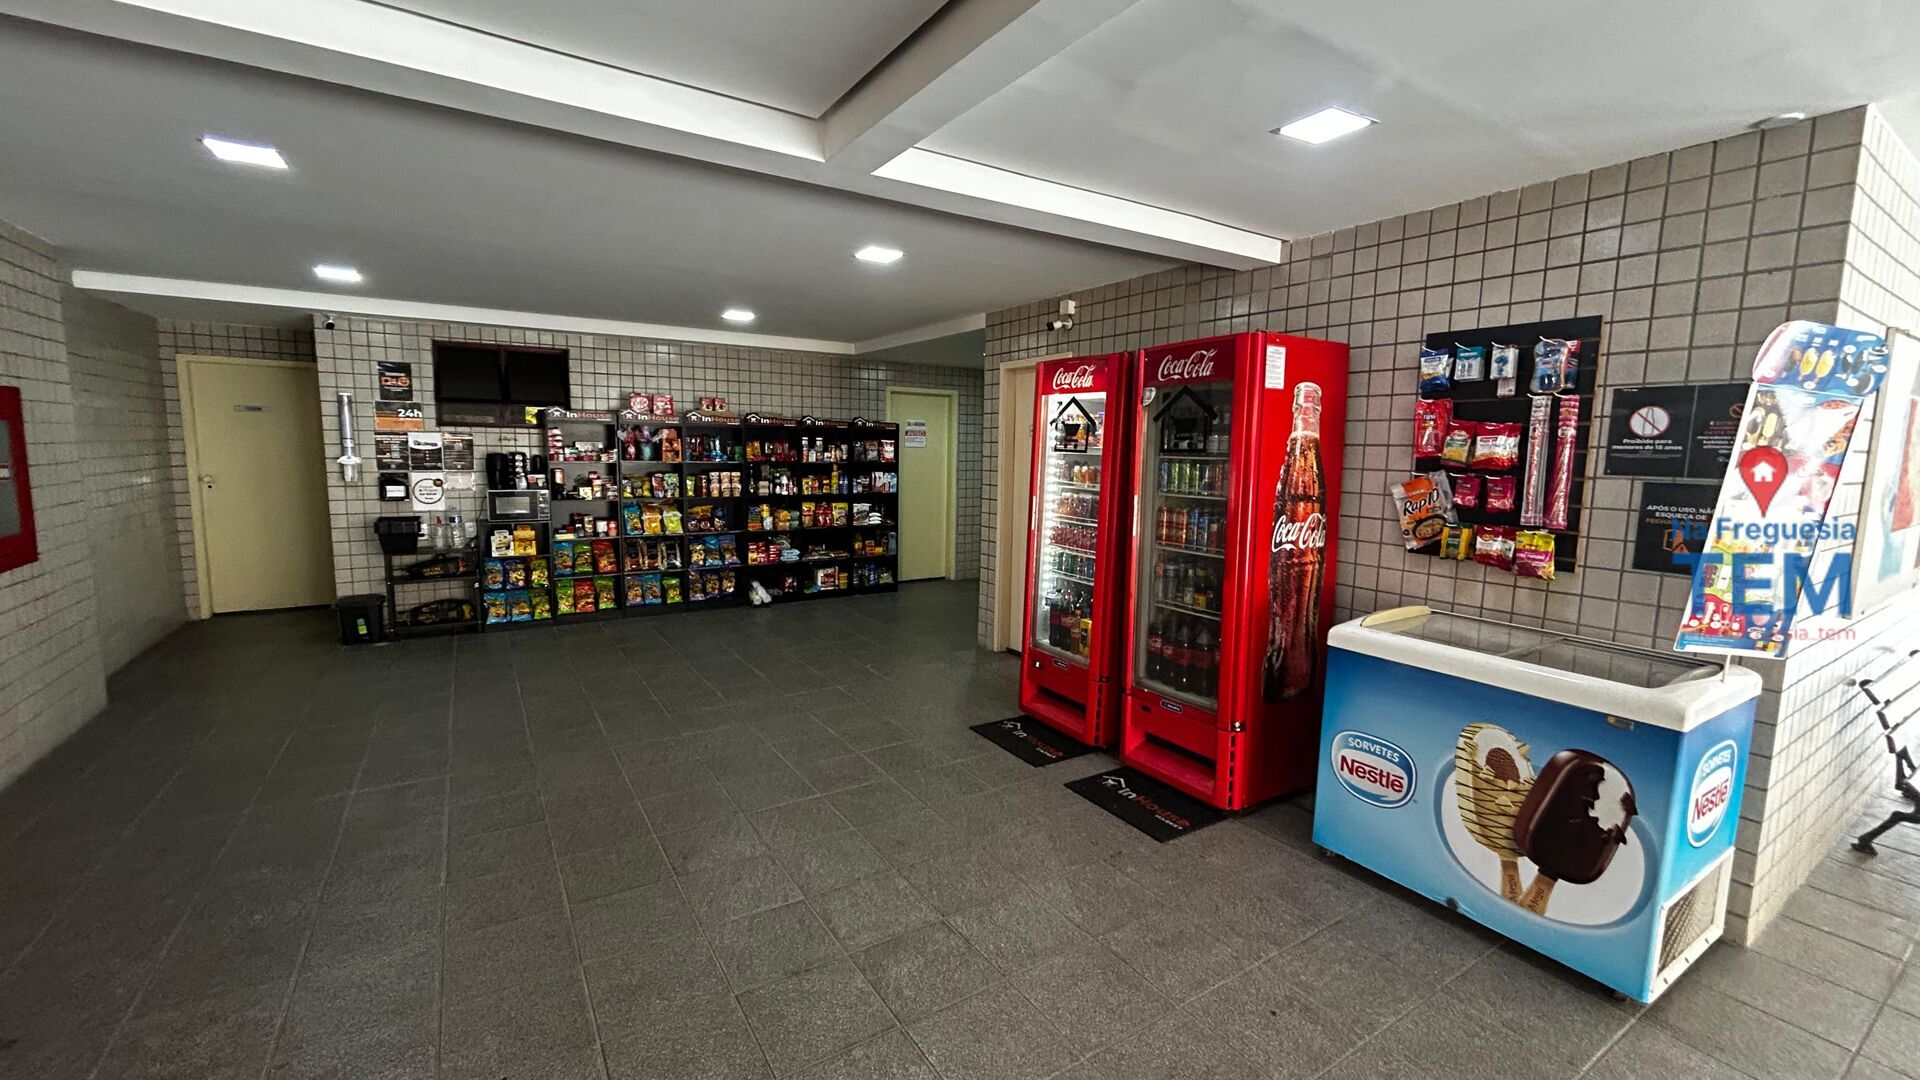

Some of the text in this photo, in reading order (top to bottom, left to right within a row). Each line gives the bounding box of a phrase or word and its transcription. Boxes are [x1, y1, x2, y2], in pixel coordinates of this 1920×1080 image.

[1158, 349, 1218, 382] Coca-Cola
[1052, 364, 1096, 390] Coca-Cola
[397, 408, 422, 418] 24h
[566, 411, 642, 419] InHouse
[637, 414, 681, 422] InHouse
[701, 415, 740, 424] InHouse
[1403, 488, 1440, 516] Rap10
[1655, 512, 1694, 520] ESQUEÇA
[1272, 513, 1326, 553] Coca-Cola
[1348, 737, 1400, 763] SORVETES
